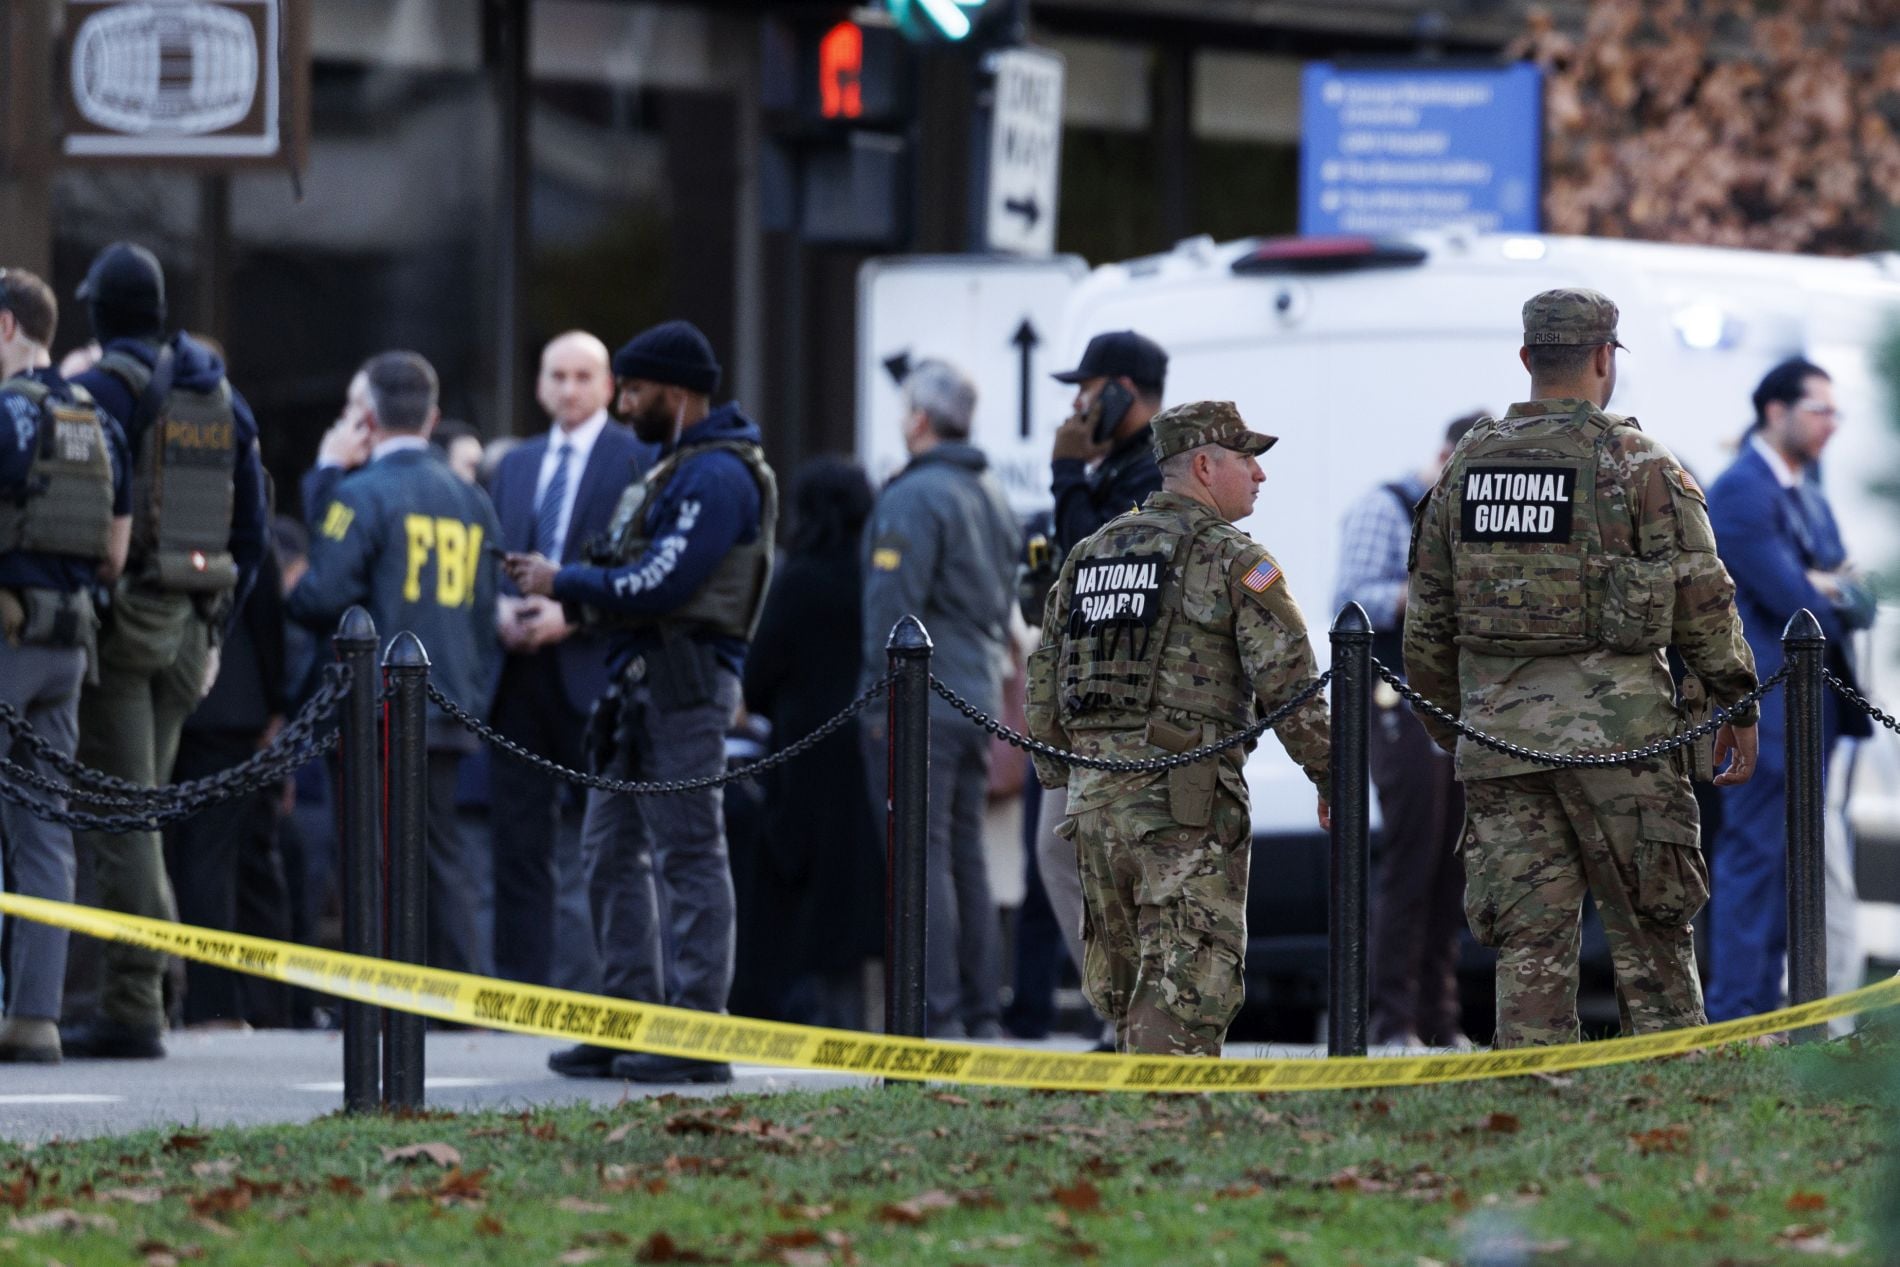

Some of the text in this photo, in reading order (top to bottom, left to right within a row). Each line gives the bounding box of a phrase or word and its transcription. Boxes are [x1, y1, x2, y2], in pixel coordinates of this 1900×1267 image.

[1534, 332, 1561, 343] RUSH
[166, 419, 233, 449] POLICE
[1467, 473, 1569, 502] NATIONAL
[1474, 504, 1555, 533] GUARD
[403, 512, 484, 609] FBI
[1075, 562, 1159, 595] NATIONAL
[1081, 592, 1146, 623] GUARD
[474, 988, 643, 1041] CRIME SCENE DO NOT CROSS
